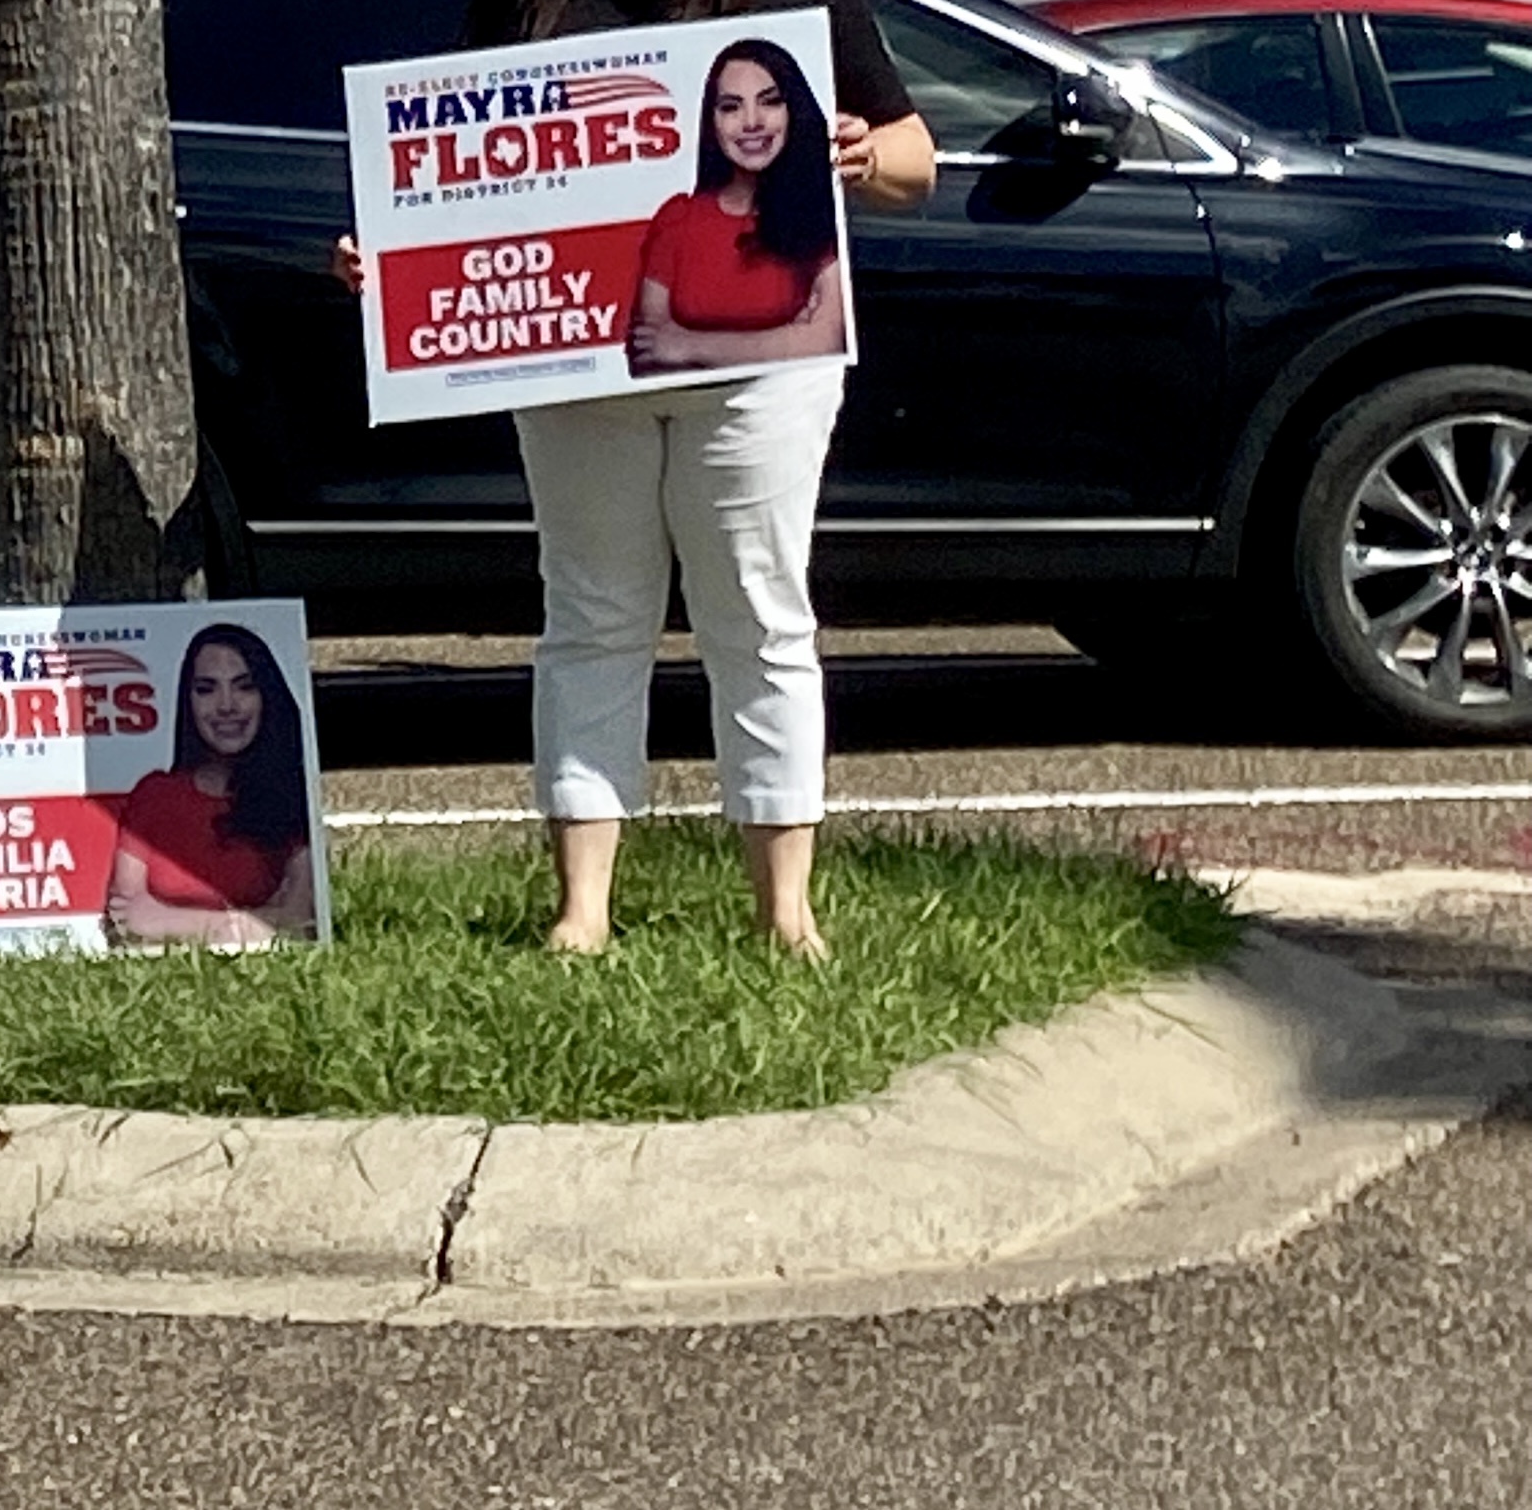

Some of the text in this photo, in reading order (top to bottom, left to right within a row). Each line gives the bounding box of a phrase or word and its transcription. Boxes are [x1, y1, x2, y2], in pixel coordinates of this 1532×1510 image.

[386, 80, 573, 134] MAYRA
[389, 106, 682, 192] FLORES
[393, 192, 433, 209] FOR
[441, 177, 537, 202] DISTRICT
[462, 240, 555, 282] GOD
[429, 270, 594, 323] FAMILY
[409, 303, 620, 361] COUNTRY
